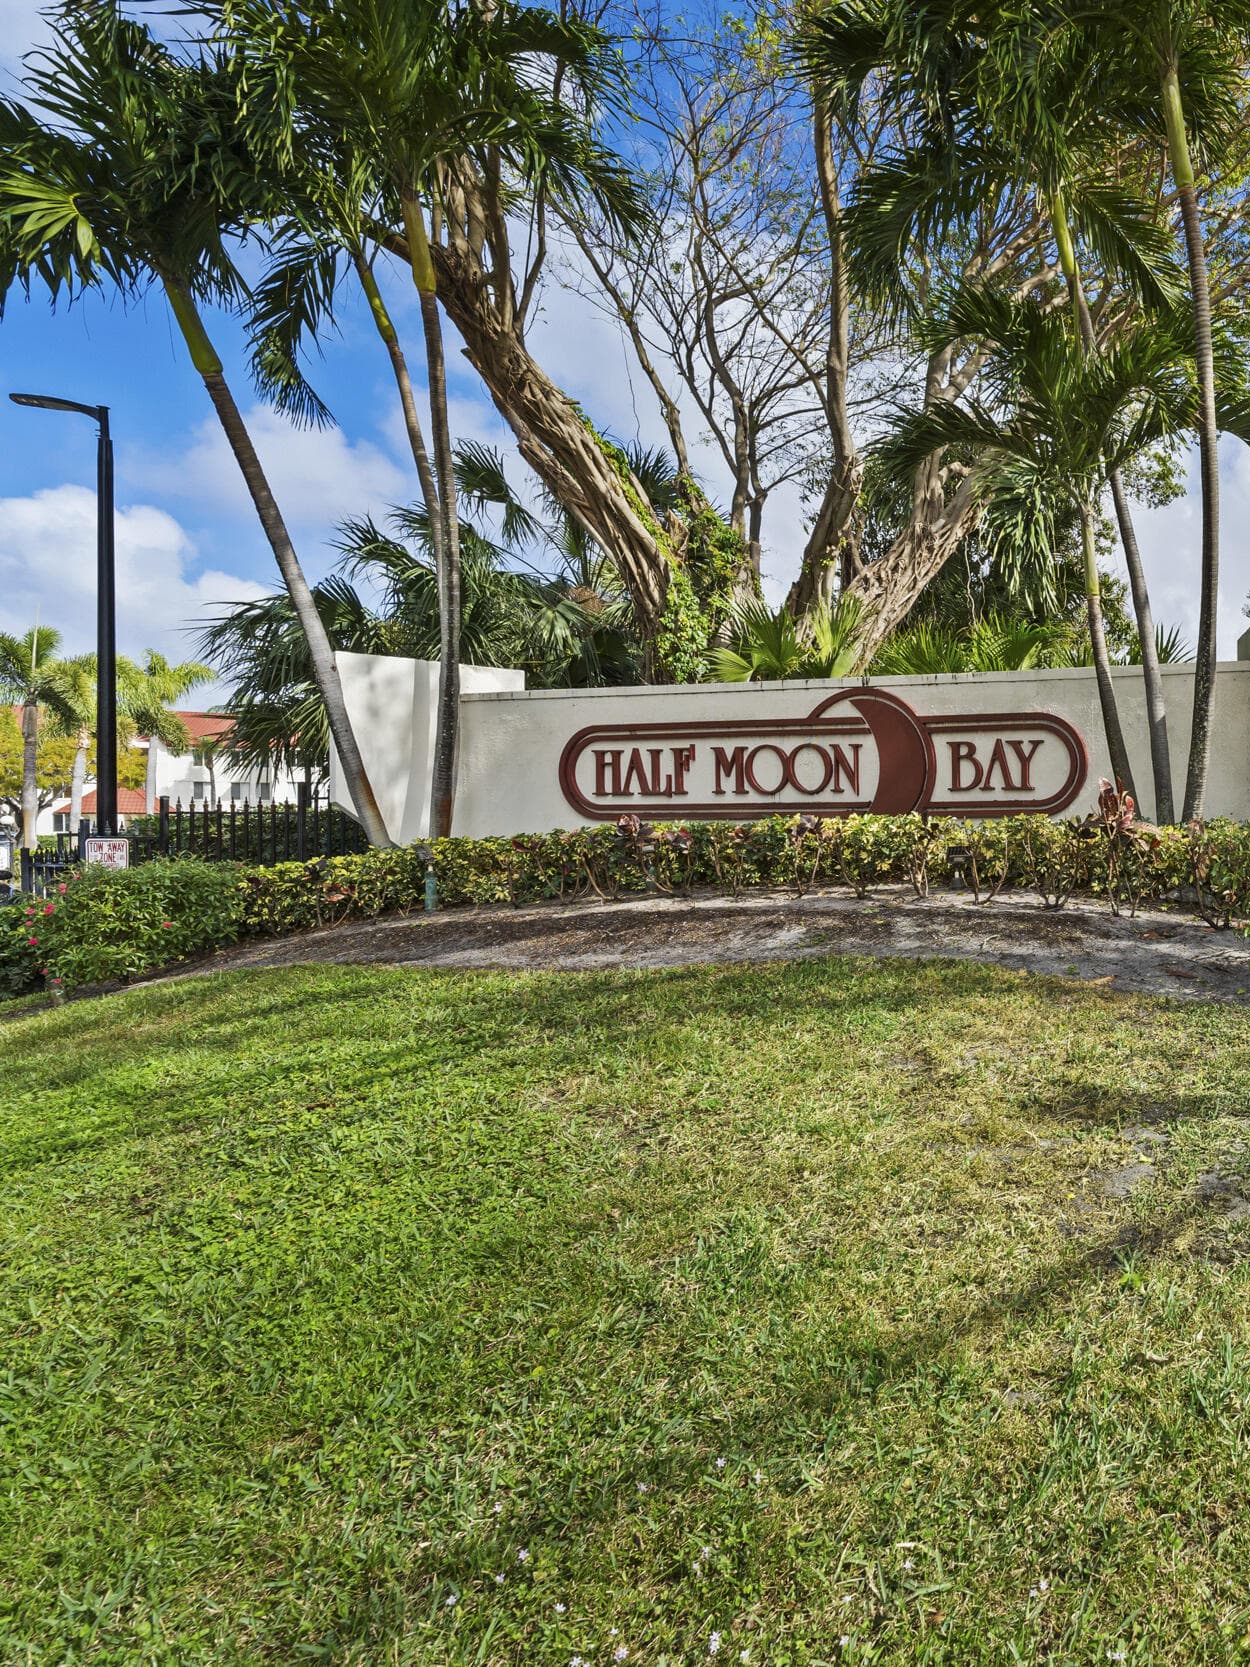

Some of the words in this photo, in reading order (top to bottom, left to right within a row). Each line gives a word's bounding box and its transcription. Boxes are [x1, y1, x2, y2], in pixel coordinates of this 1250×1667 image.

[592, 744, 695, 797] HALF
[711, 743, 863, 796] MOON
[947, 738, 1044, 792] BAY
[90, 842, 103, 852] TOW
[107, 842, 125, 852] AWAY
[99, 852, 117, 862] ZONE
